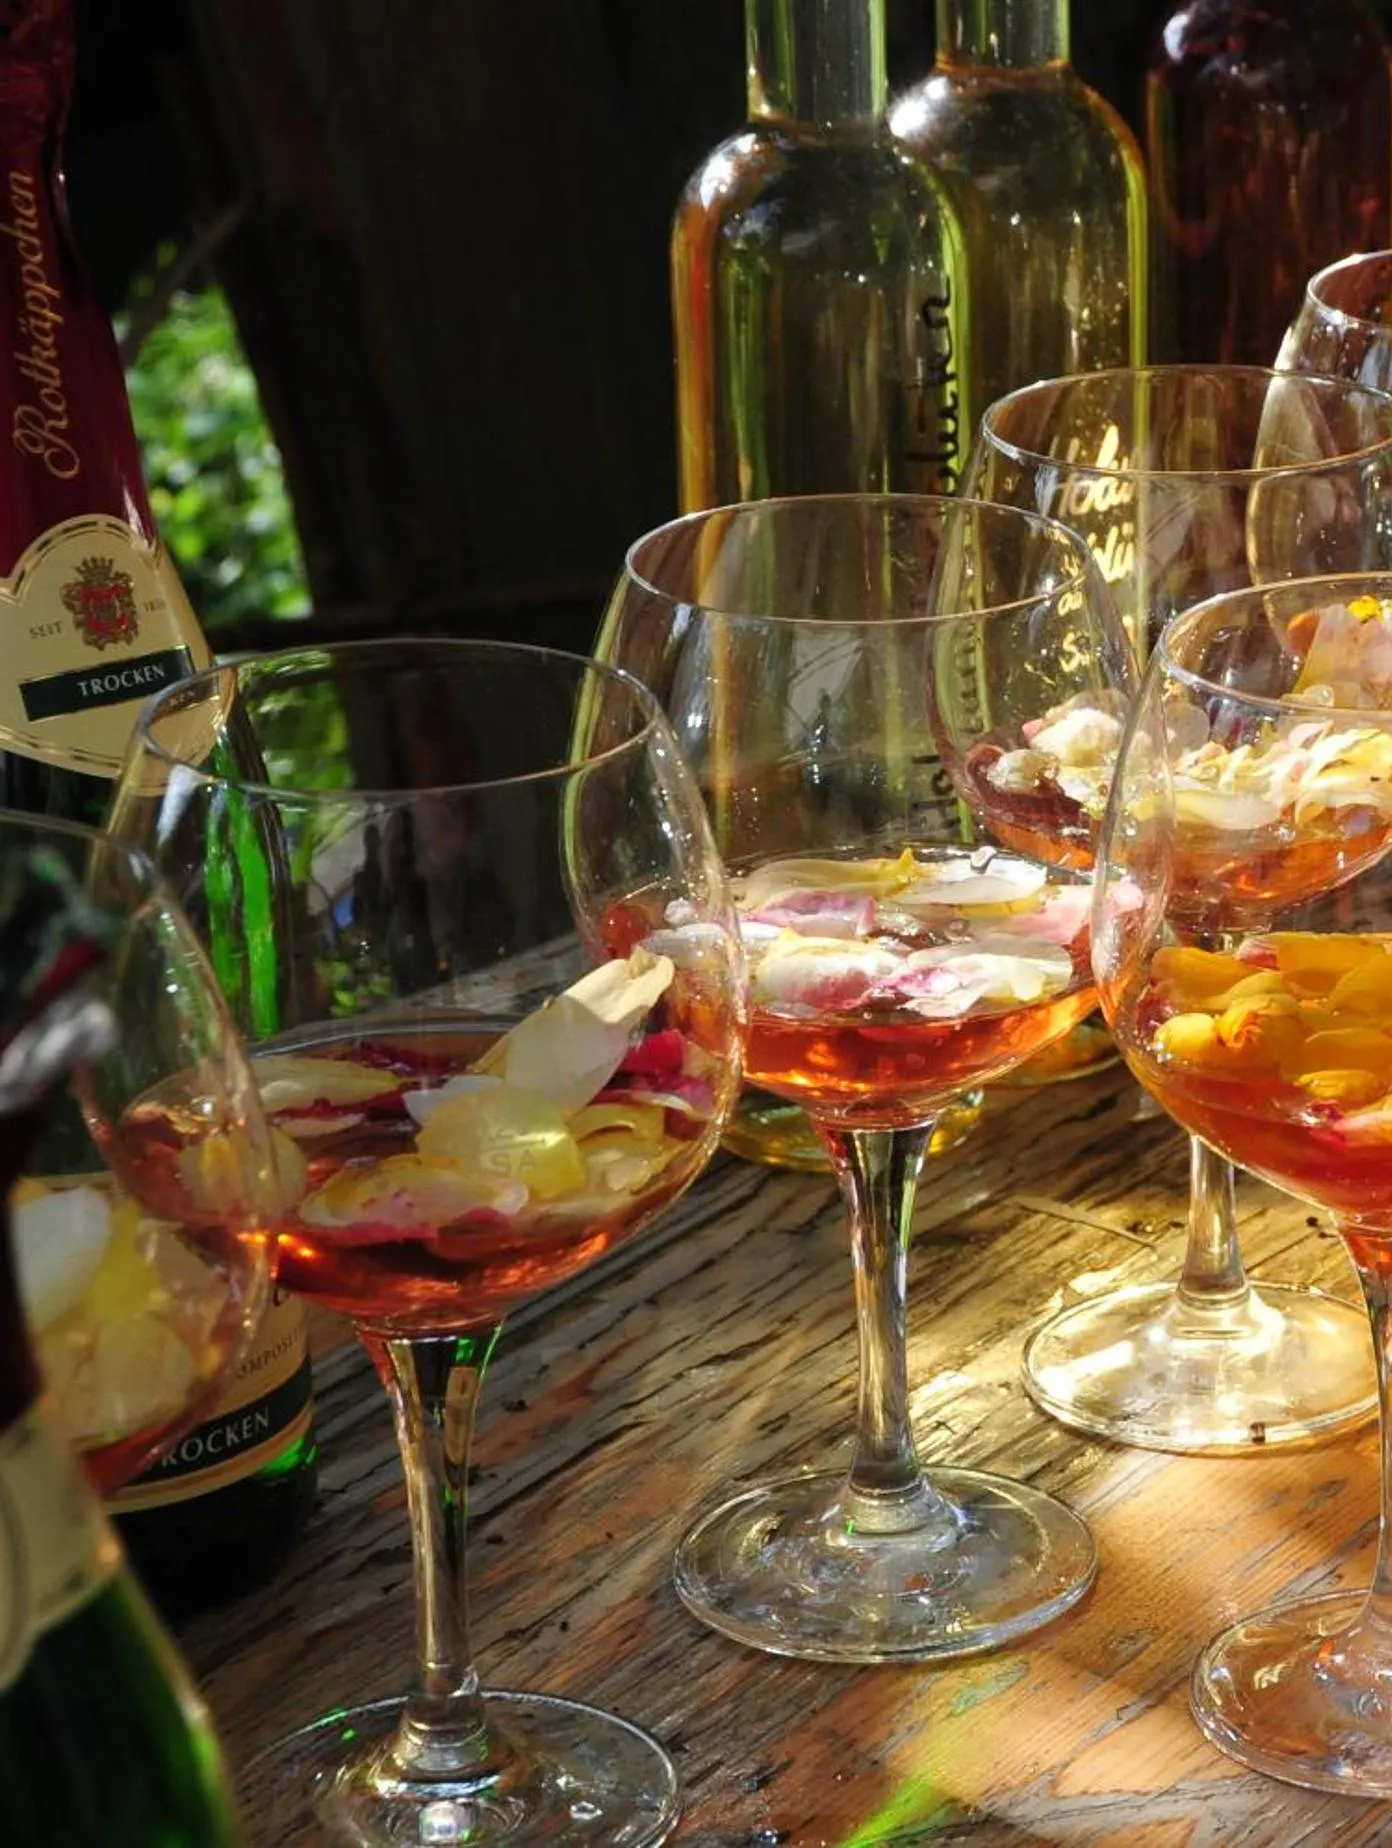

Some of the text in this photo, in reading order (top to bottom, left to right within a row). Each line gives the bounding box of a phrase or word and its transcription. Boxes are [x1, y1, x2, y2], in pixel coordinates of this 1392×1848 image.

[0, 169, 80, 479] Rotkäppchen
[29, 621, 63, 639] SEIT
[77, 662, 165, 698] TROCKEN
[160, 1404, 270, 1467] ROCKEN
